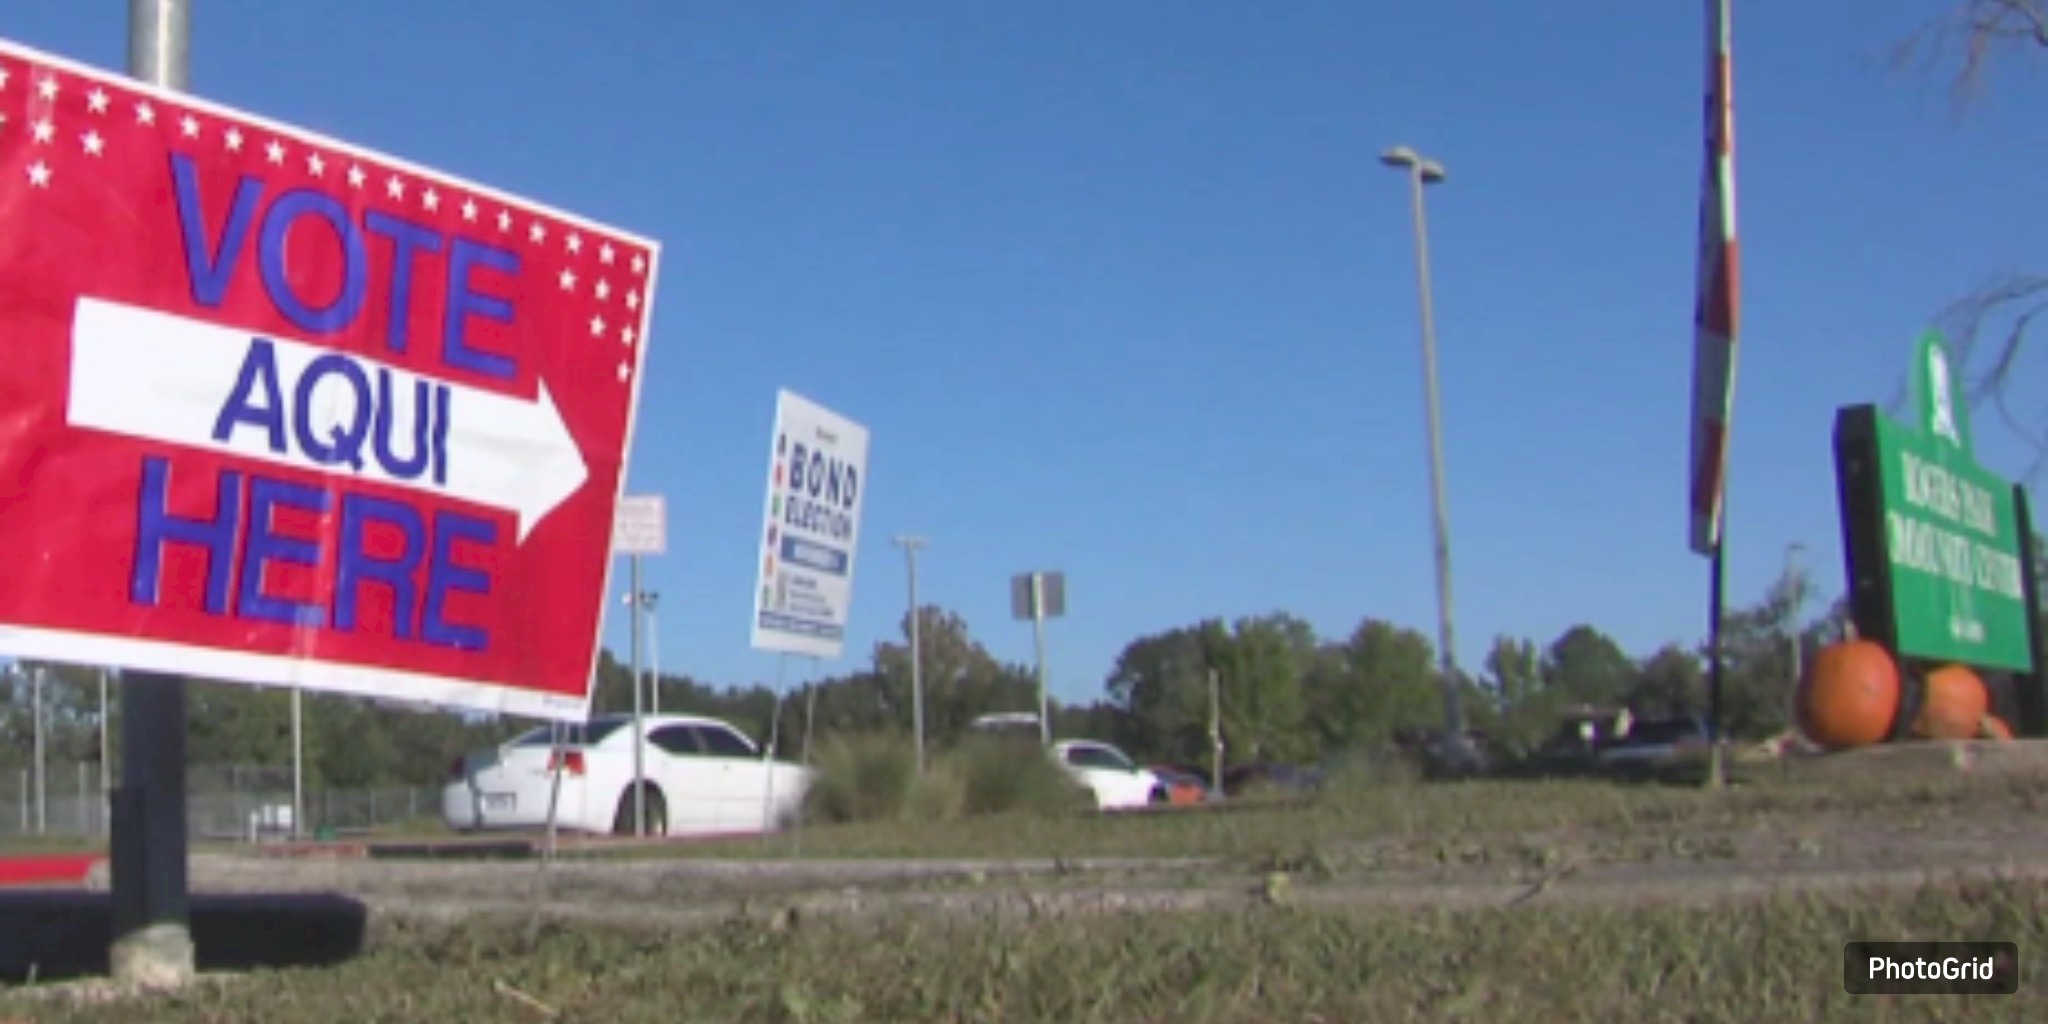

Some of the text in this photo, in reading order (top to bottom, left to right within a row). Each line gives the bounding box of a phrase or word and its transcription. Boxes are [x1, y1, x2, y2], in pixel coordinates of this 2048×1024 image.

[171, 153, 519, 379] VOTE
[211, 337, 450, 485] AQUI
[790, 443, 857, 510] BOND
[131, 455, 498, 652] HERE
[785, 496, 850, 541] ELECTION
